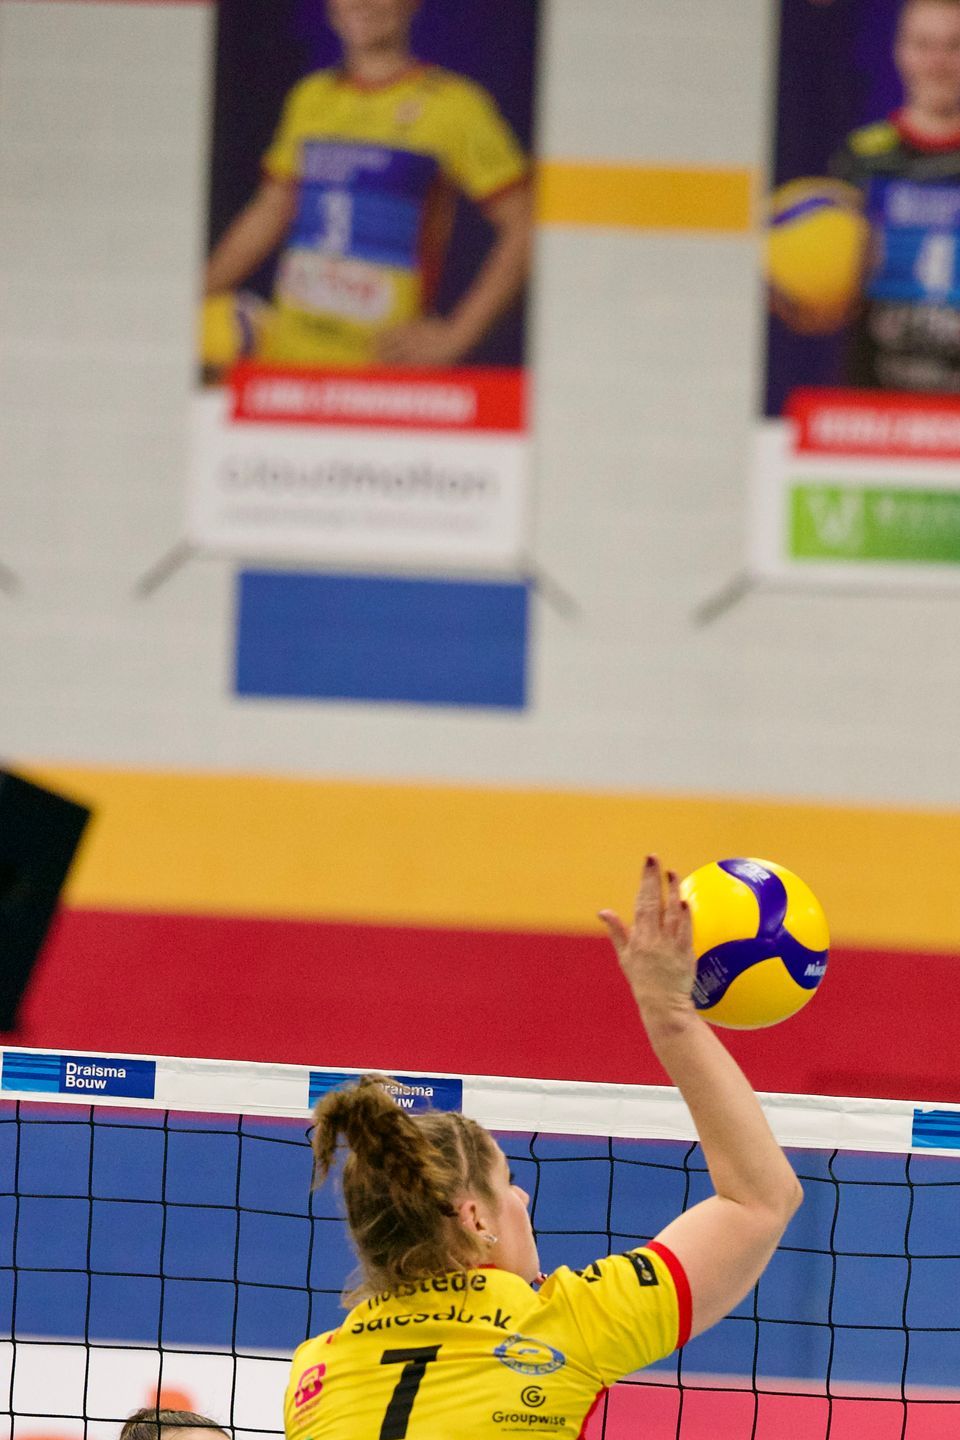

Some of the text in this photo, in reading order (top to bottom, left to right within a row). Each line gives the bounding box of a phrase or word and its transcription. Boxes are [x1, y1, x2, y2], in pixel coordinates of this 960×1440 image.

[66, 1062, 126, 1079] Draisma
[65, 1074, 107, 1090] Bouw
[492, 1410, 567, 1426] Groupwise
